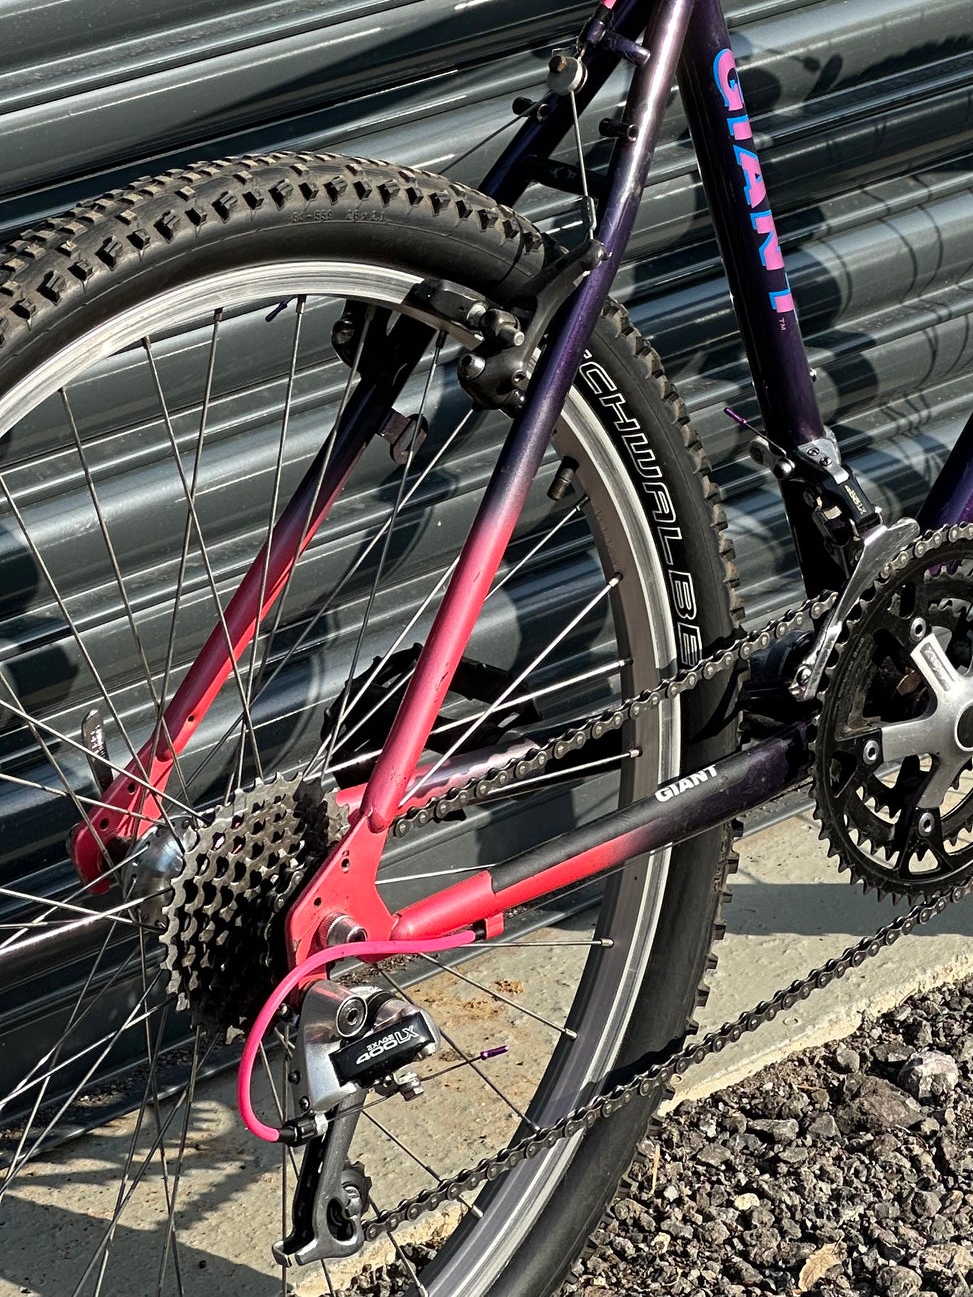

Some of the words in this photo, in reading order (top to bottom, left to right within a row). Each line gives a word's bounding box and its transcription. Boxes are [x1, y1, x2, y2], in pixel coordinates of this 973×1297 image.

[713, 48, 797, 322] GIANT
[579, 349, 702, 668] CHWALBE
[654, 764, 718, 802] GIANT
[366, 1033, 396, 1052] EXAGE
